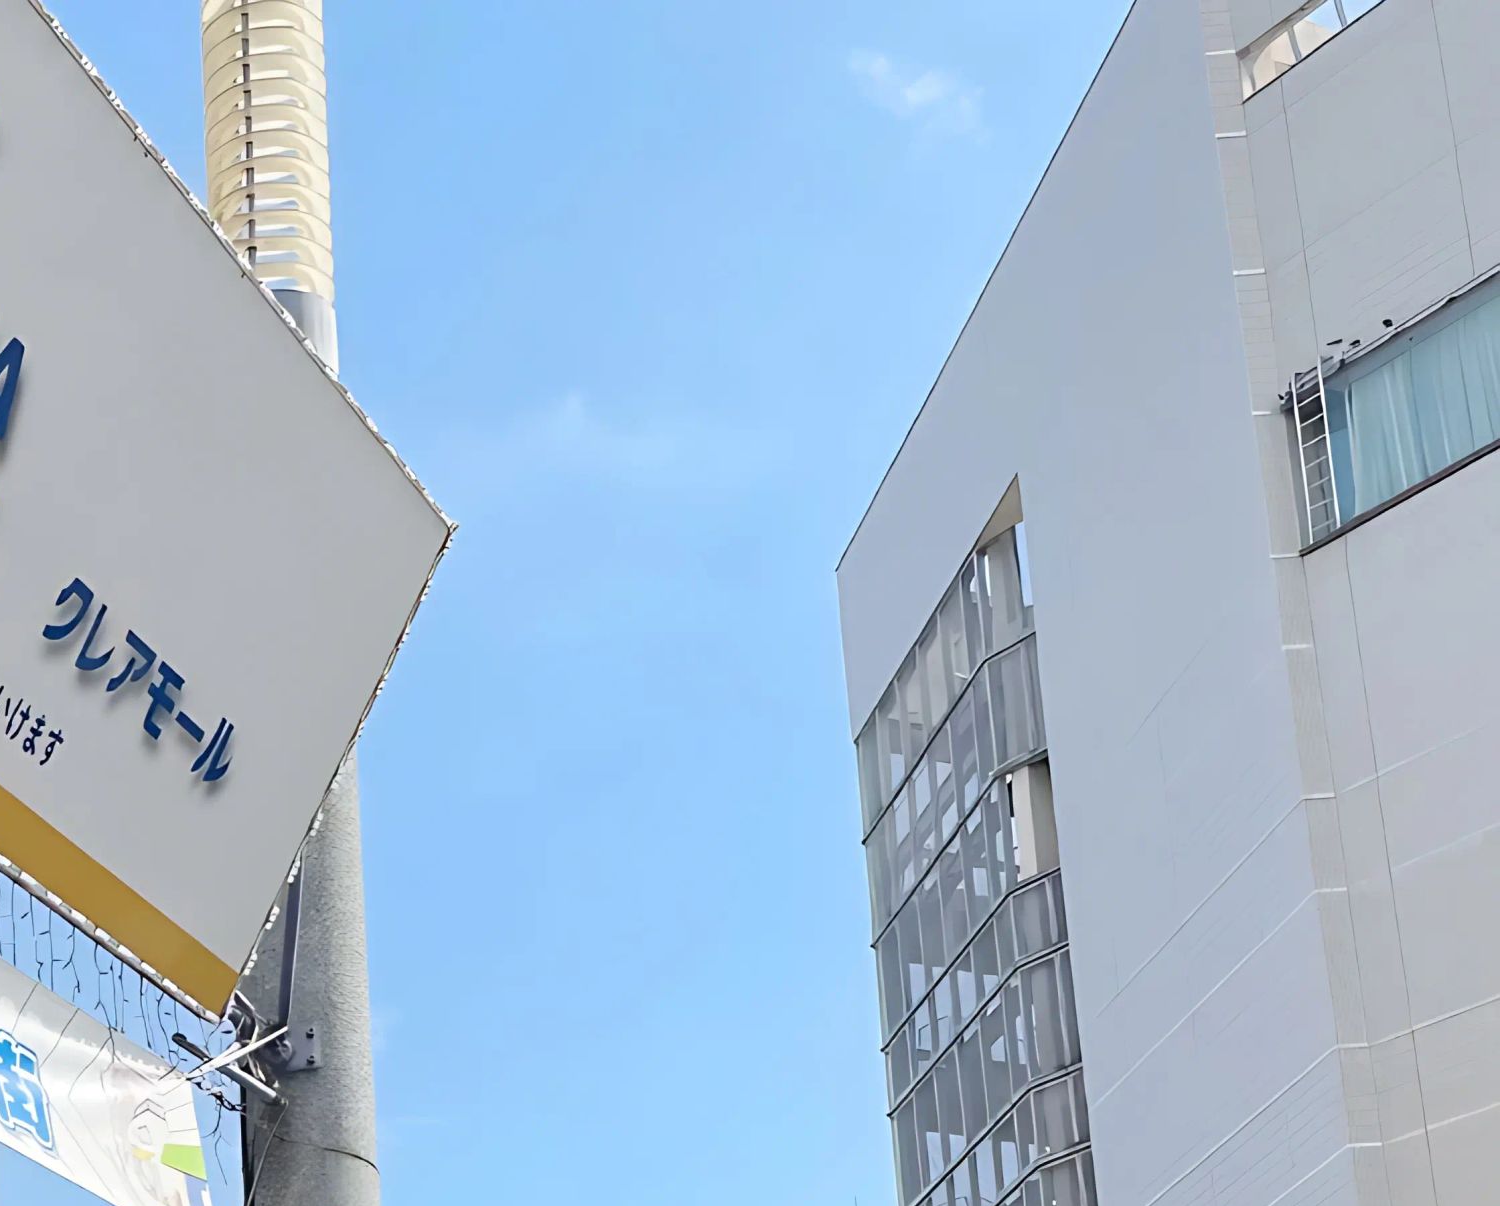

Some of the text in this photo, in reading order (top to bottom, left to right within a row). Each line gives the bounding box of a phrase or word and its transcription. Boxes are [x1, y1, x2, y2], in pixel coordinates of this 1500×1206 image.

[41, 576, 237, 786] クレアモール
